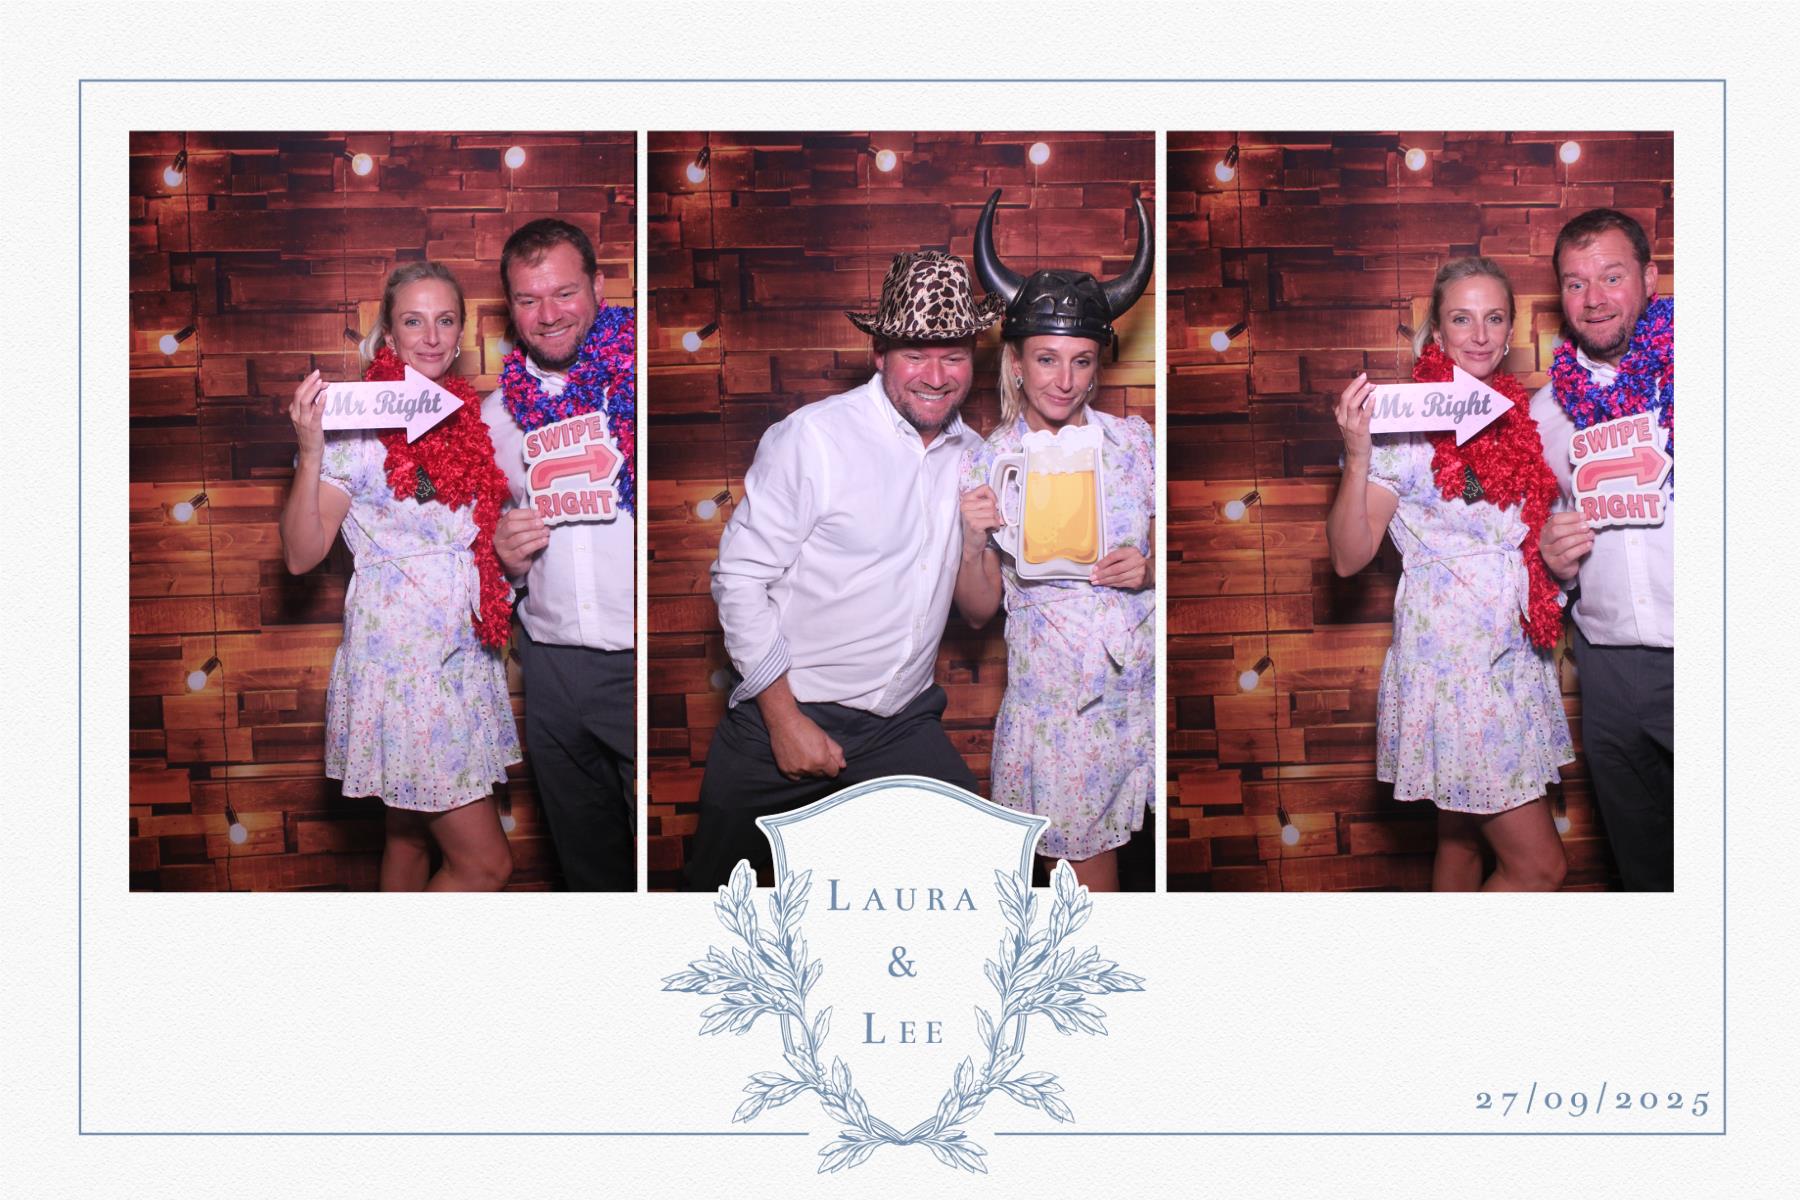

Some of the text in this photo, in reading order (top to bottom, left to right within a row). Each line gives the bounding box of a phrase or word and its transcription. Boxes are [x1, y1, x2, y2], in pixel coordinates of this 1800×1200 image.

[324, 389, 443, 422] Mr Right
[1371, 390, 1493, 424] Mr Right
[526, 415, 604, 458] SWIPE
[1572, 416, 1652, 459] SWIPE
[534, 489, 613, 519] RIGHT
[1580, 493, 1660, 522] RIGHT
